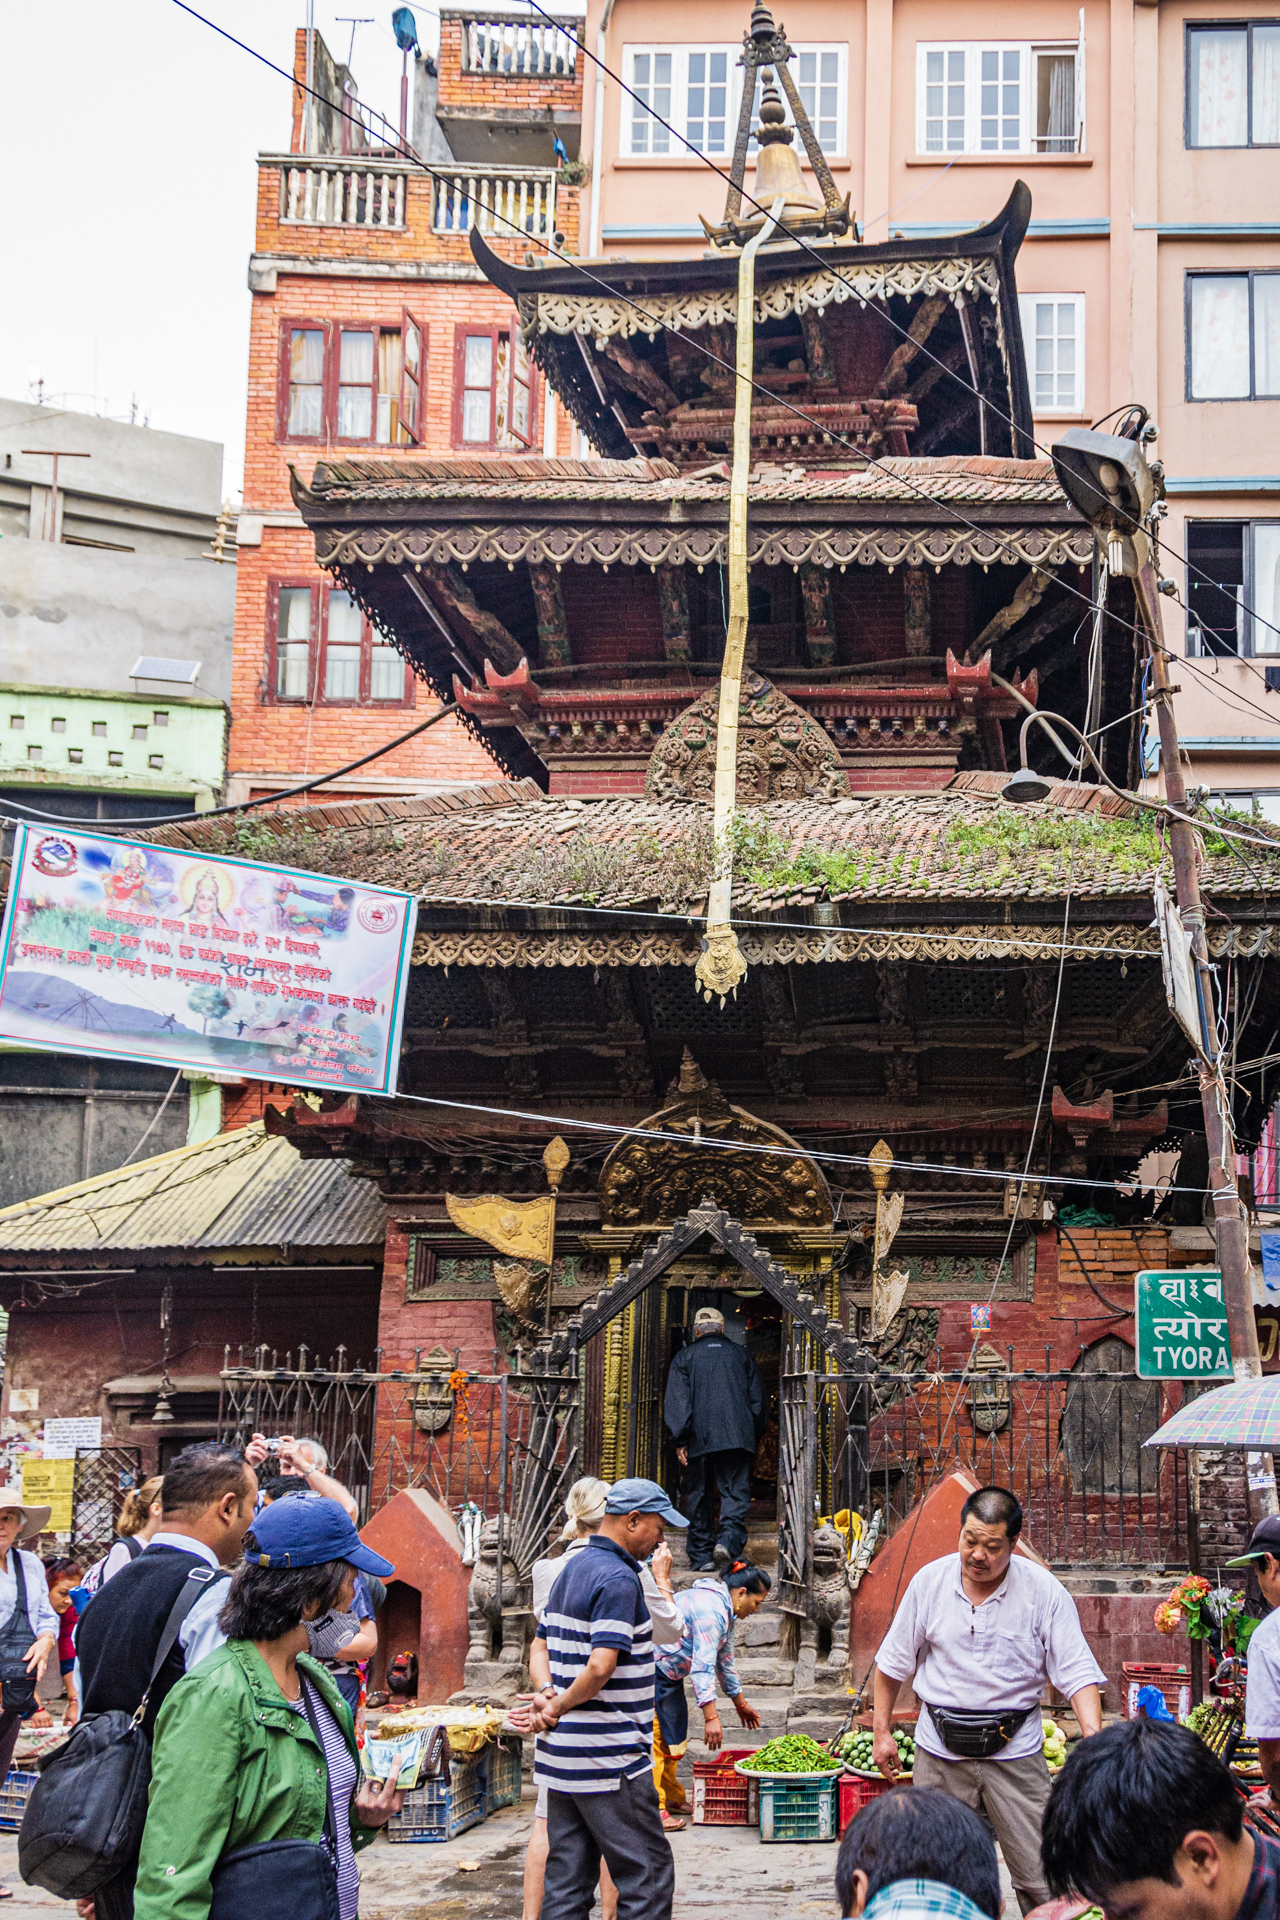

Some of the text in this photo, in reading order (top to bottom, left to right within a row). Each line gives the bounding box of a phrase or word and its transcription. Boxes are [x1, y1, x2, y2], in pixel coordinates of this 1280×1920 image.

[161, 918, 184, 933] महान
[189, 922, 207, 938] चाड
[211, 923, 239, 942] विजया
[265, 936, 280, 953] शुभ
[89, 928, 115, 945] नेपाल
[226, 951, 249, 967] पावन
[253, 956, 291, 975] अवसरमा
[19, 942, 63, 962] उत्तरोत्तर
[95, 954, 113, 972] सुख
[225, 973, 248, 991] लागि
[280, 985, 325, 1004] शुभकामना
[327, 993, 349, 1009] व्यक्त
[339, 1033, 360, 1042] शाक्य
[347, 1063, 376, 1075] परिवार
[1153, 1346, 1230, 1370] TYORA
